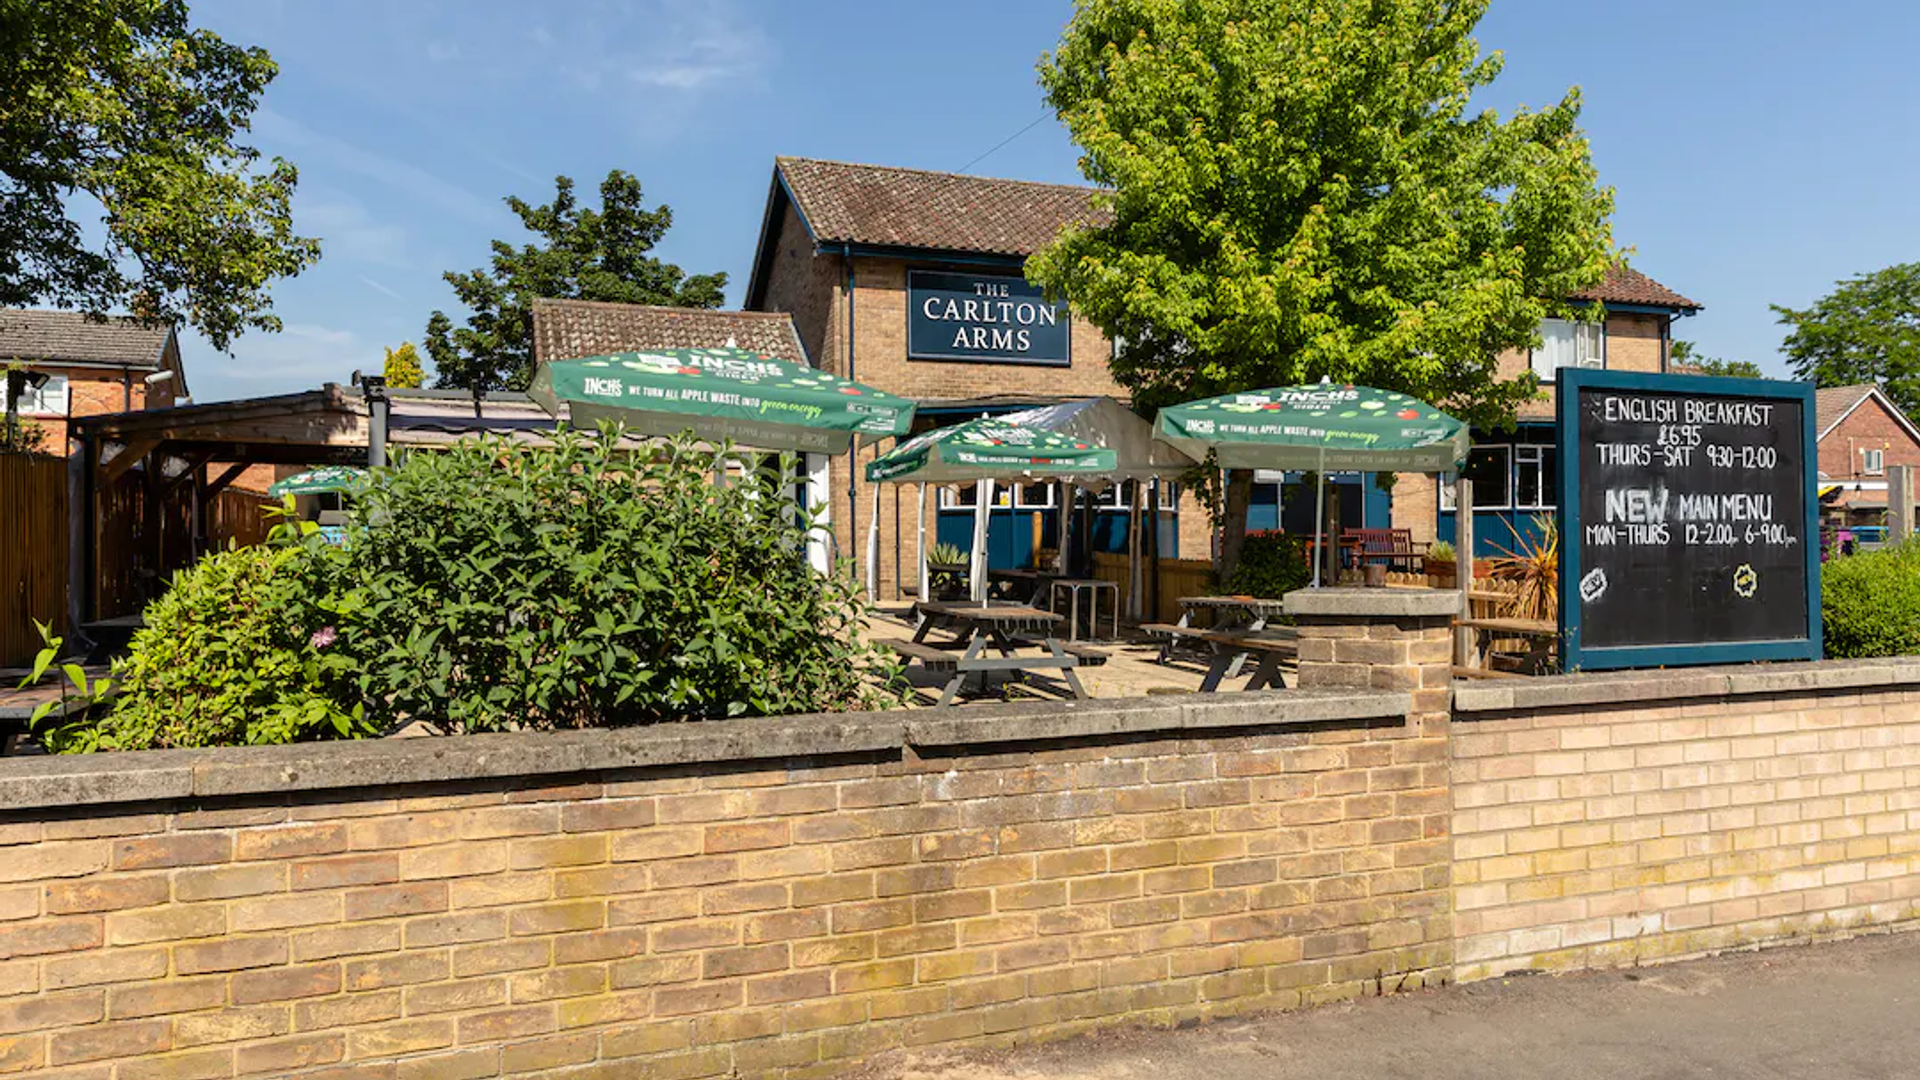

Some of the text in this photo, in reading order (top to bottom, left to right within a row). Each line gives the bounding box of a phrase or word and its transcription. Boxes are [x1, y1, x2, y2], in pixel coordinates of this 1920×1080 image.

[974, 283, 1009, 297] THE
[923, 297, 1056, 325] CARLTON
[952, 327, 1030, 350] ARMS
[629, 386, 822, 420] WE TURN ALL APPLE WASTE INTO green energy
[1605, 398, 1773, 426] ENGLISH BREAKFAST
[1231, 425, 1246, 433] TURN
[1260, 425, 1281, 434] APPLE
[1284, 426, 1309, 436] WASTE
[1309, 428, 1325, 436] INTO
[1350, 432, 1380, 445] energy
[1656, 424, 1702, 446] £6.95
[1605, 488, 1772, 524] NEW MAIN MENU
[1586, 524, 1670, 546] MON-THURS
